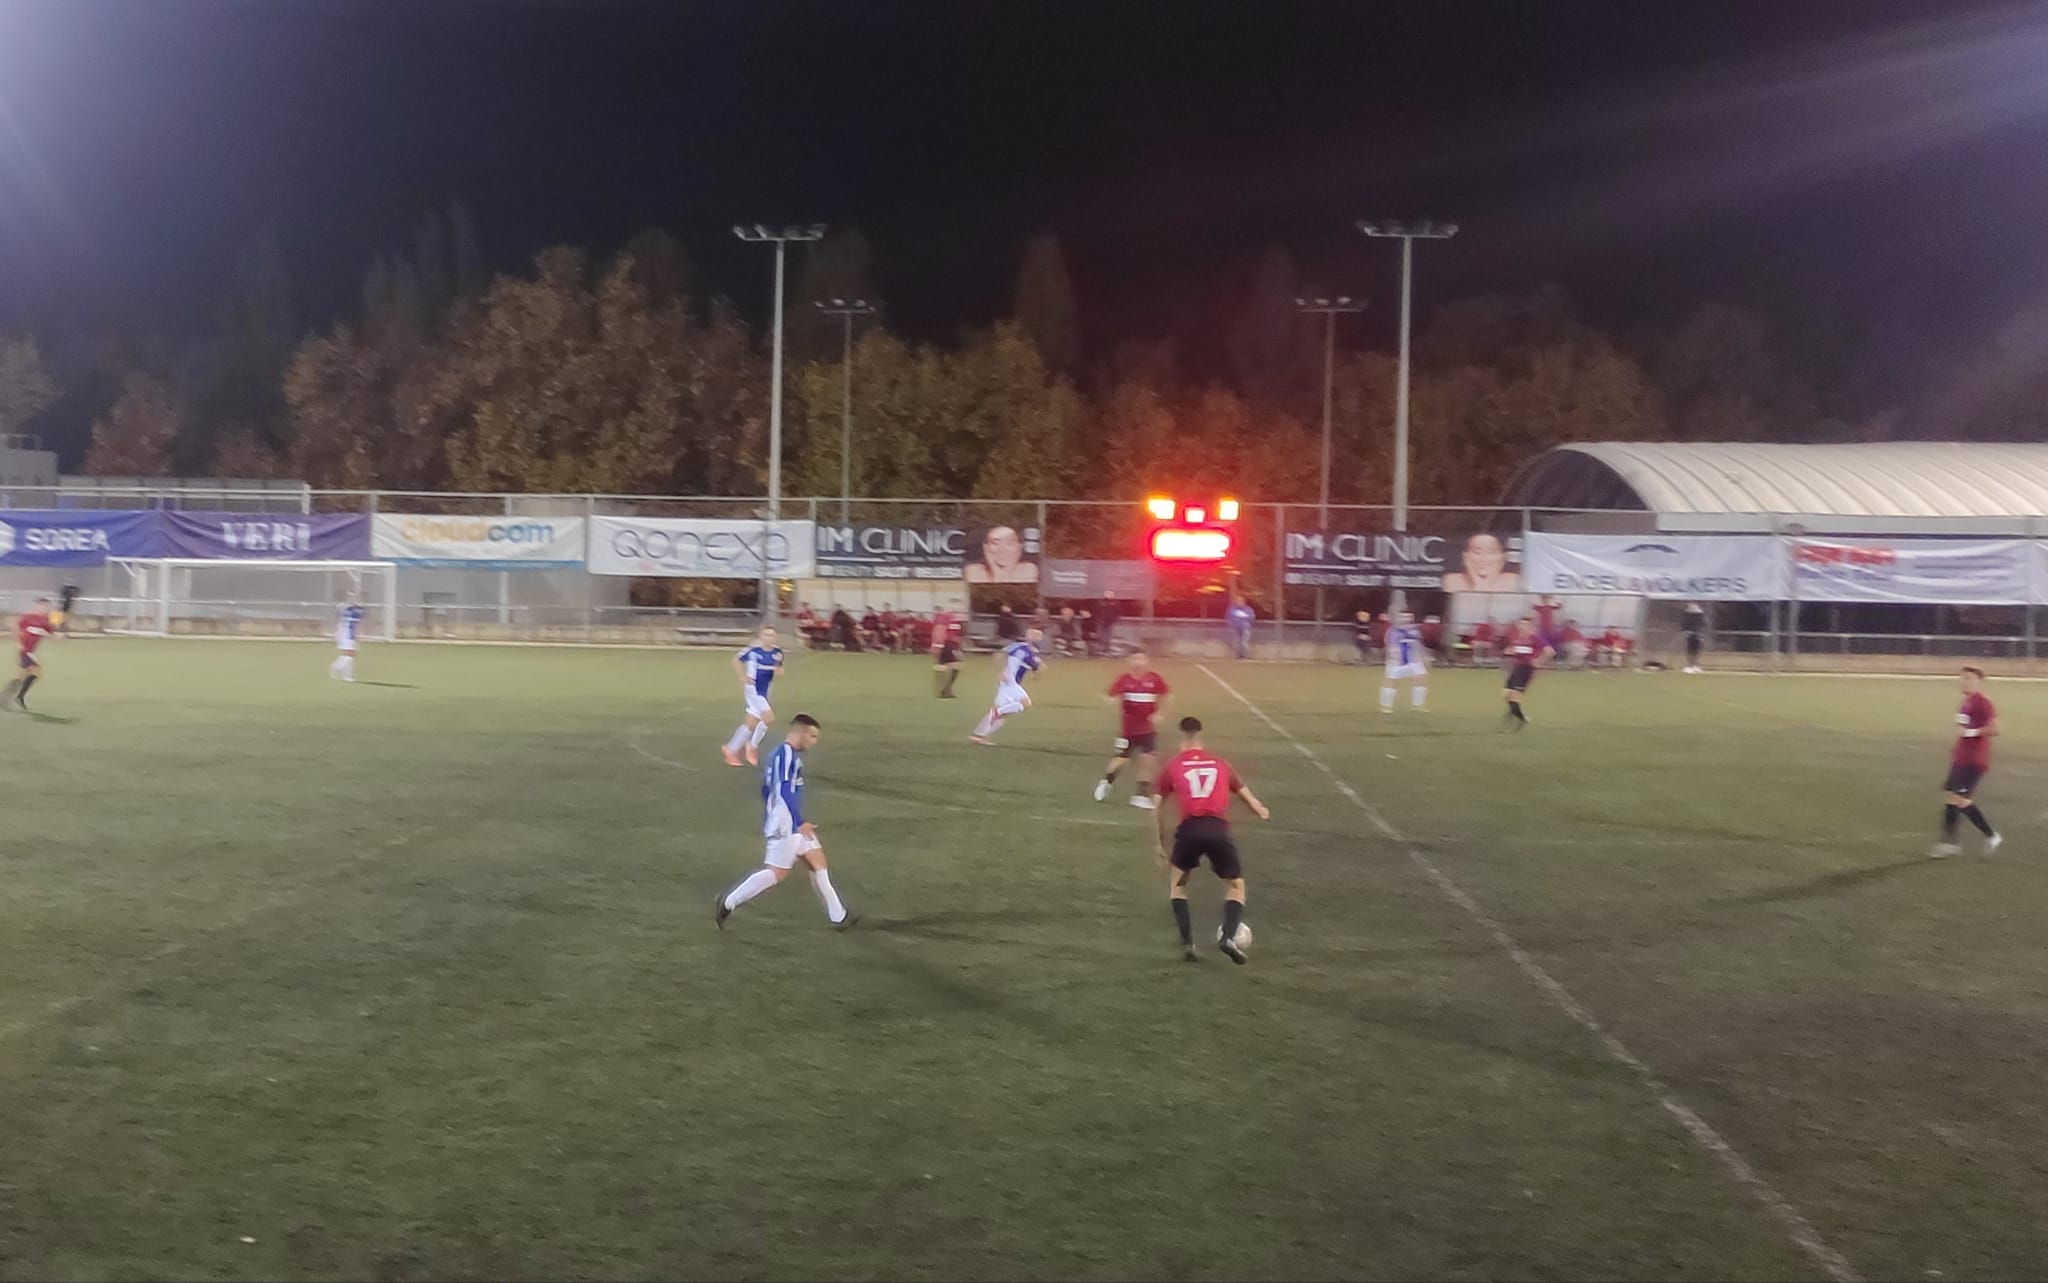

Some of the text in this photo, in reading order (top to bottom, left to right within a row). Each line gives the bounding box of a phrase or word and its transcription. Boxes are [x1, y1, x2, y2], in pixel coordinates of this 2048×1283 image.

[25, 528, 109, 550] SOREA
[818, 527, 966, 554] IM CLINIC
[1286, 532, 1446, 562] IM CLINIC
[1184, 768, 1218, 798] 17
